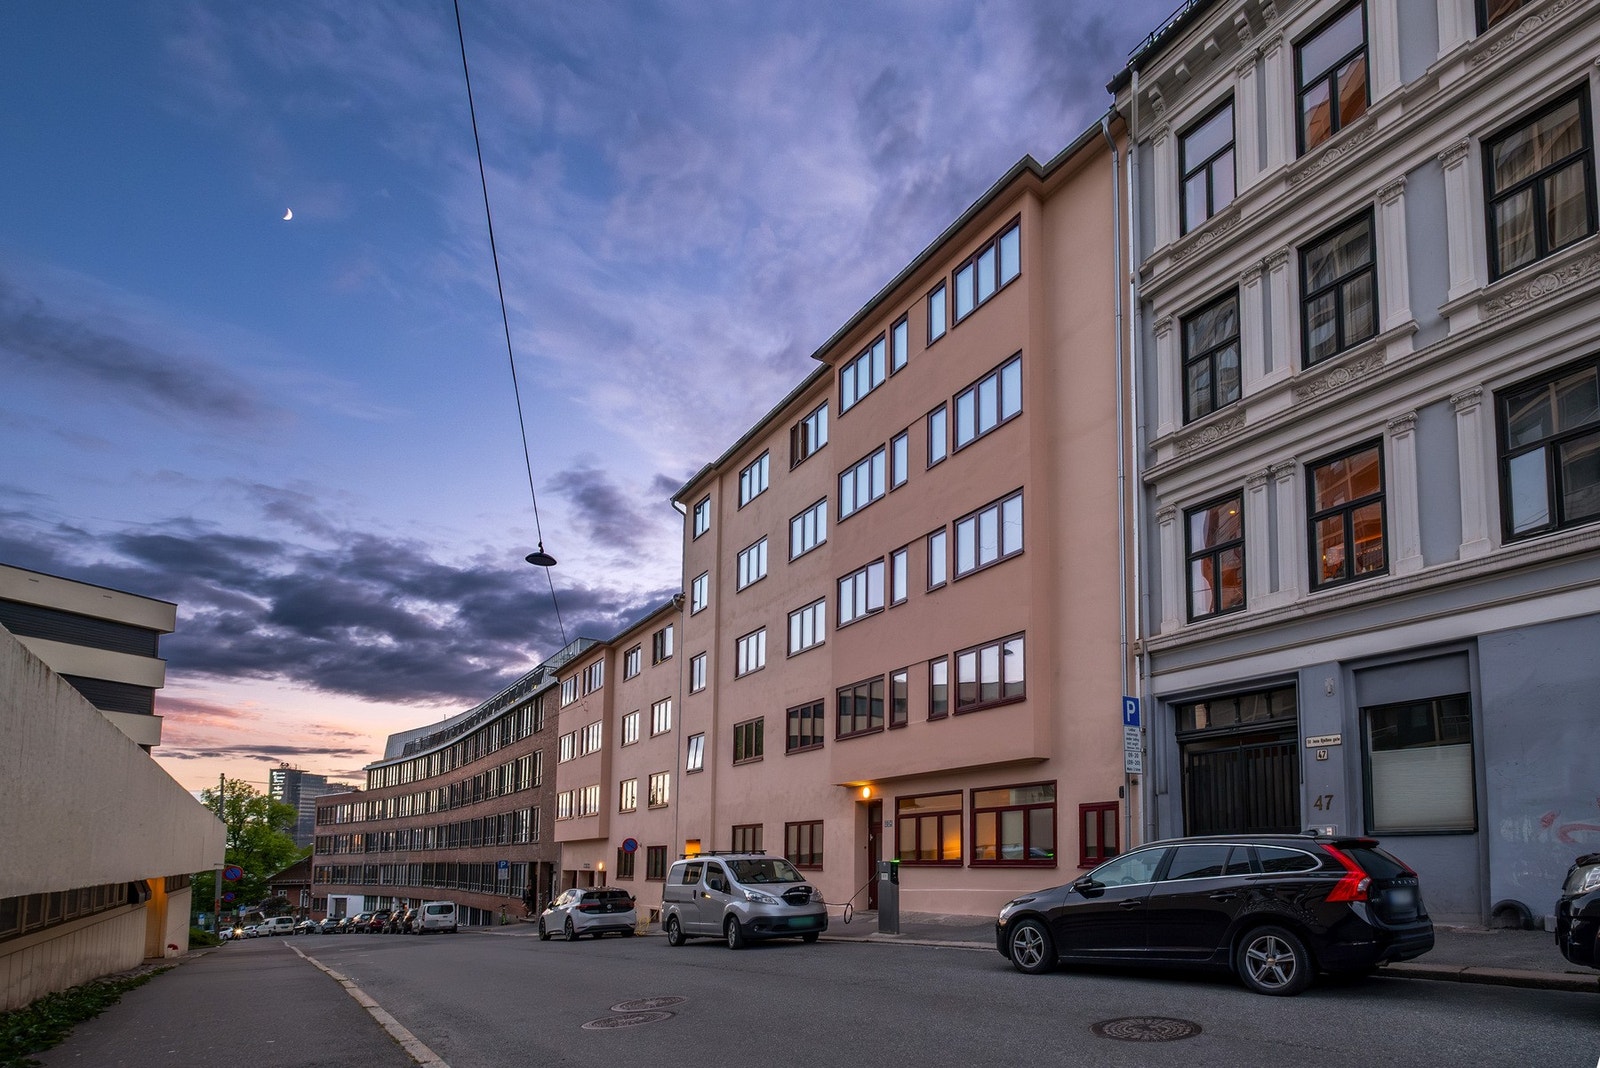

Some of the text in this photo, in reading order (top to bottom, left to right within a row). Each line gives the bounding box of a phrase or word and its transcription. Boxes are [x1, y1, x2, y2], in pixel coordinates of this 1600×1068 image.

[1126, 700, 1136, 722] P
[1318, 751, 1326, 759] 47
[1313, 794, 1334, 811] 47
